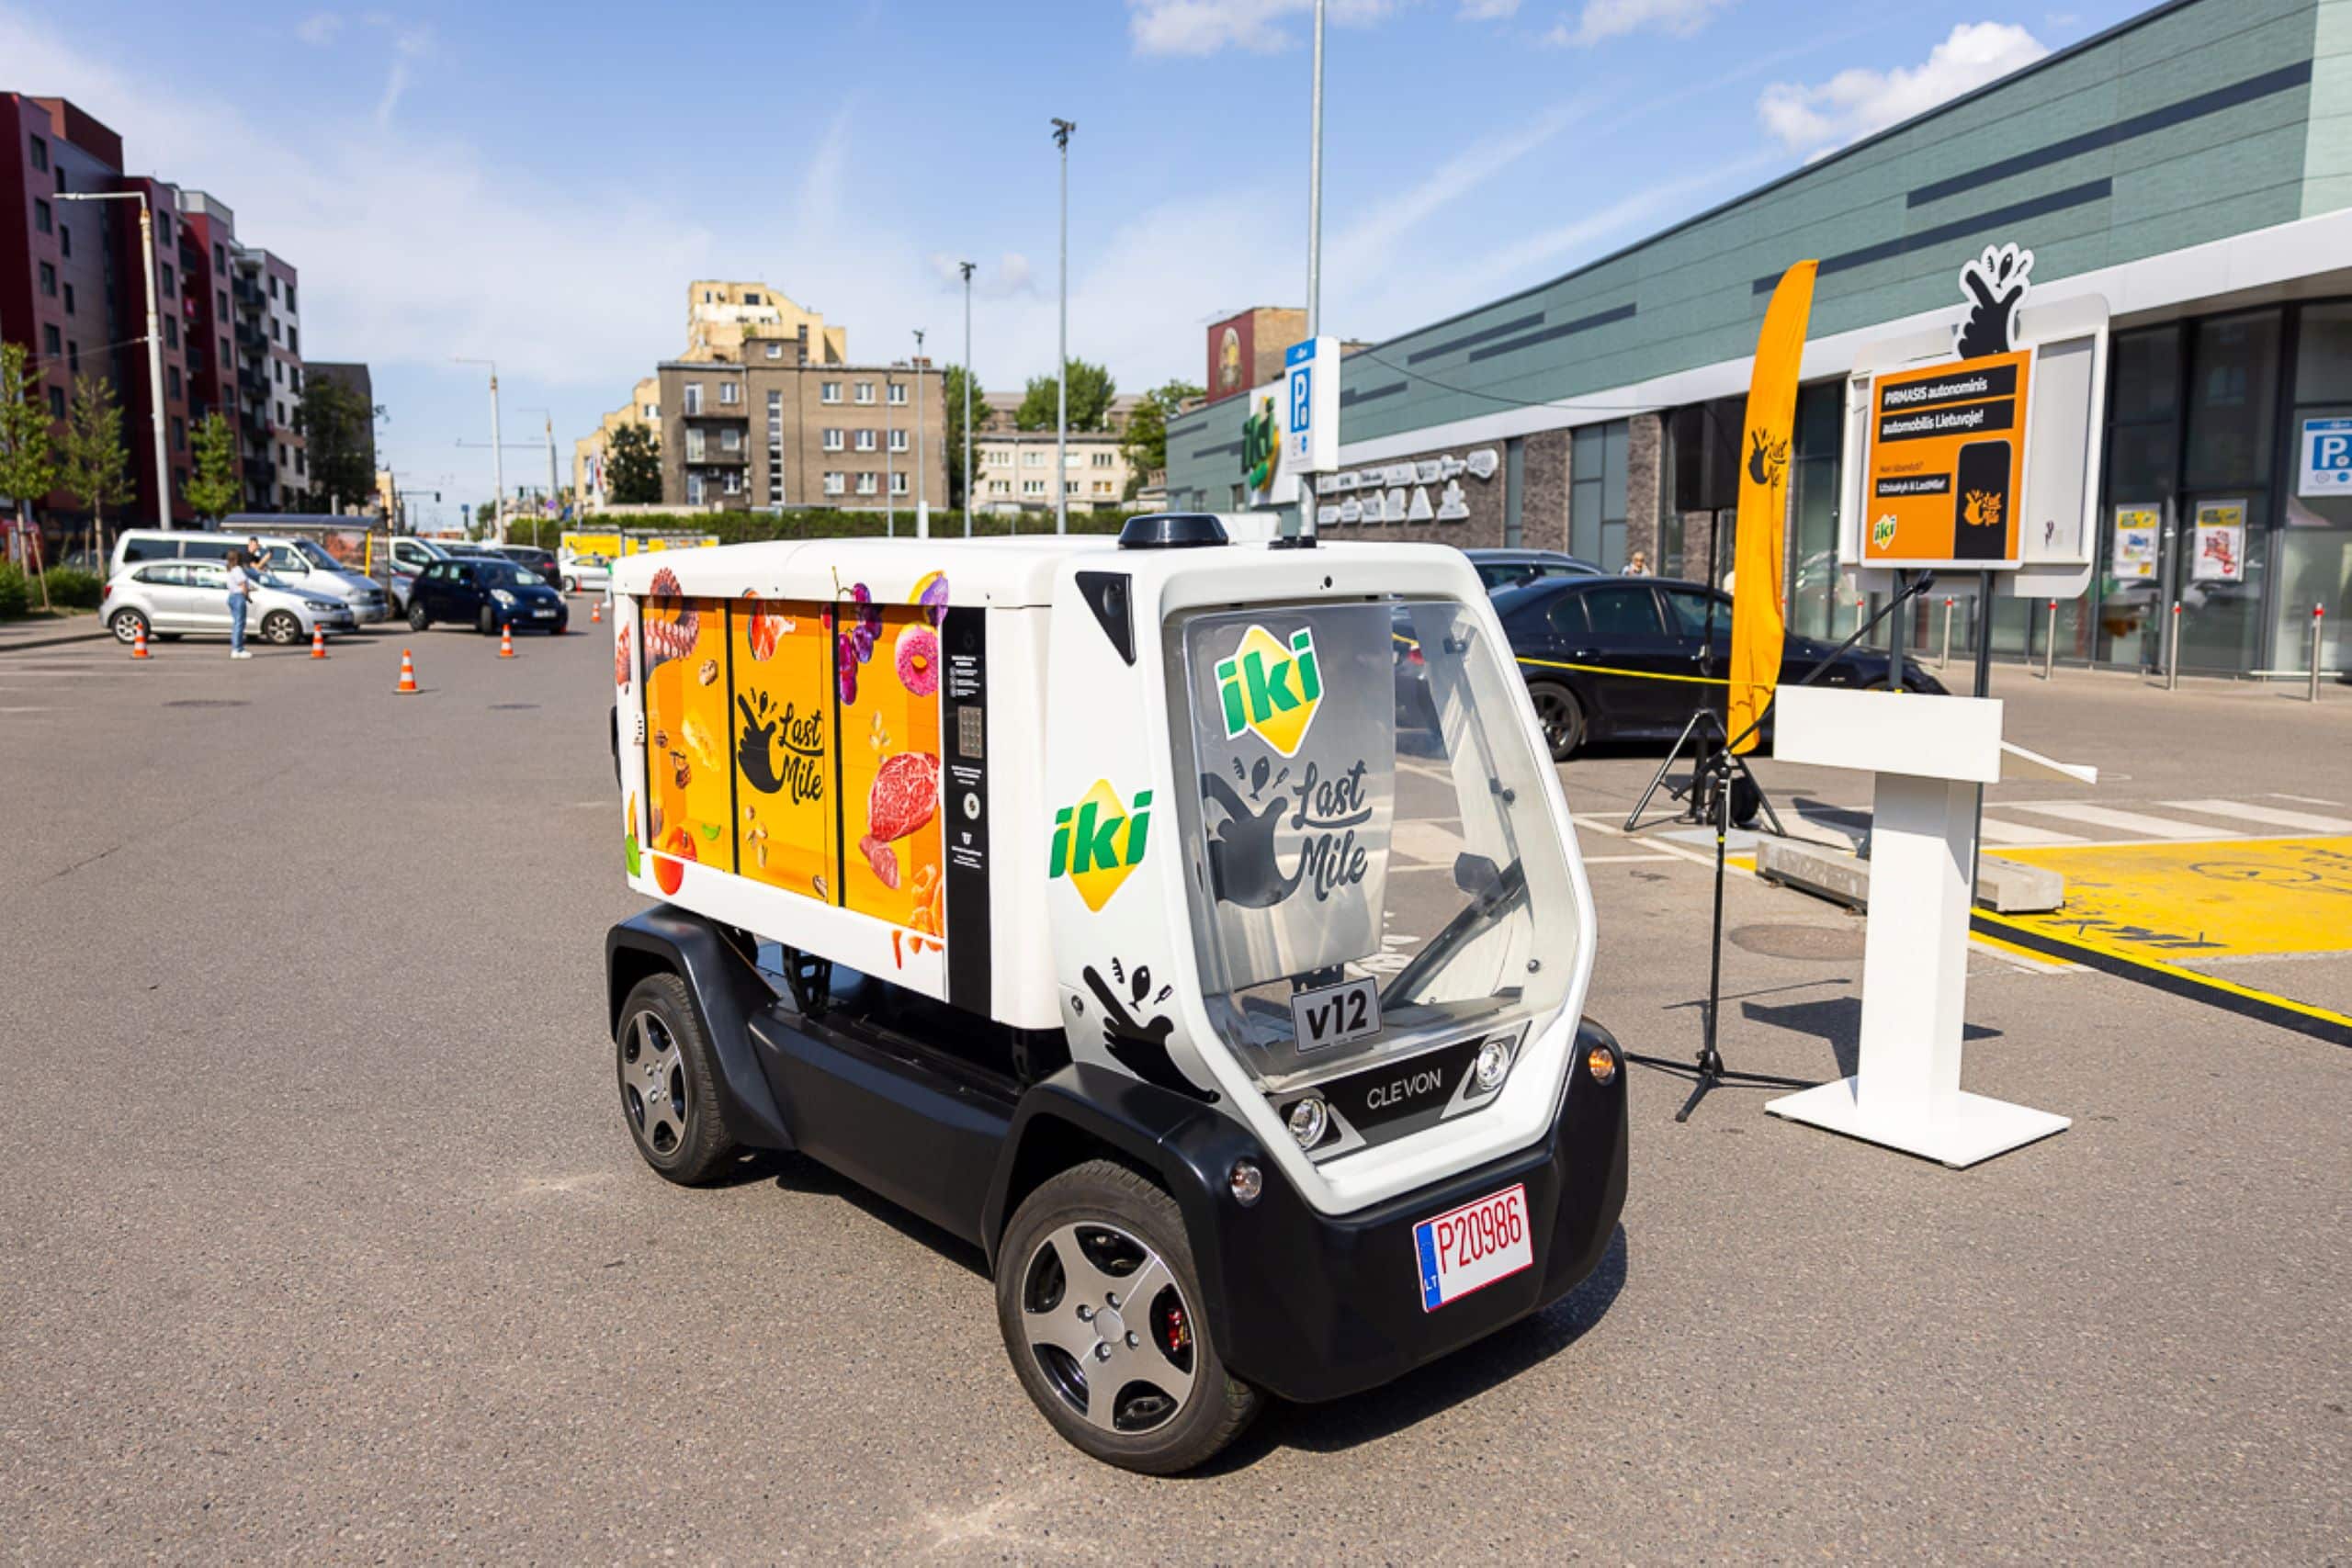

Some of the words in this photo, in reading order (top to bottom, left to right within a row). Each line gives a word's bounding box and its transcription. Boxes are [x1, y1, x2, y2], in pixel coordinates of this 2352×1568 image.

[1884, 386, 1928, 405] PIRMASIS
[1928, 377, 1988, 399] autonominis
[1883, 415, 1935, 434] automobilis
[1935, 409, 1984, 428] Lietuvoje!
[2321, 437, 2347, 468] P
[1217, 631, 1320, 736] iki
[778, 702, 823, 756] Last
[781, 754, 823, 805] Mile
[1291, 759, 1372, 829] Last
[1049, 789, 1153, 879] iki
[1298, 829, 1368, 901] Mile
[1366, 1067, 1442, 1110] CLEVON
[1437, 1196, 1521, 1274] P20986
[1424, 1274, 1438, 1292] LT
